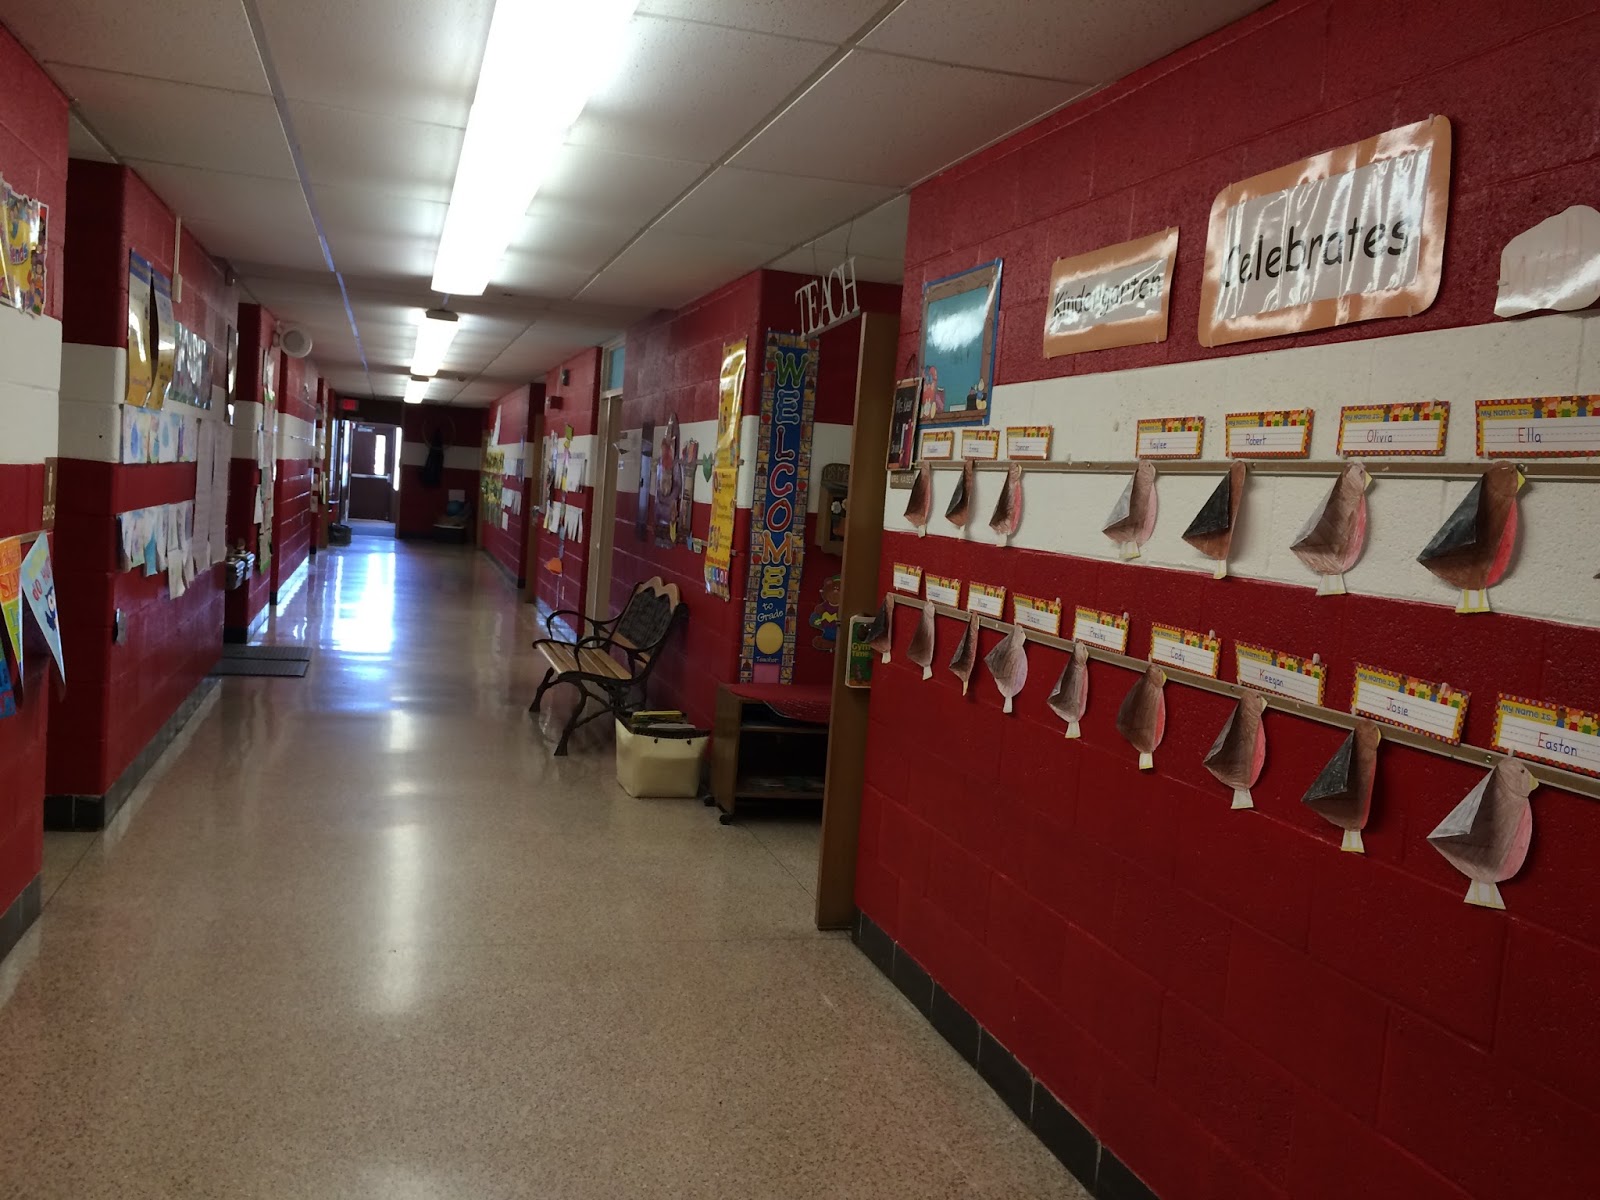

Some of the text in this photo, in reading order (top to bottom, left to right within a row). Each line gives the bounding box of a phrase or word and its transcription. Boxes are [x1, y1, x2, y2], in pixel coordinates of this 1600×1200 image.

[1221, 216, 1412, 288] Celebrates
[795, 256, 861, 341] TEACH
[1054, 274, 1163, 317] Kindergarten
[1493, 409, 1516, 417] Name
[1245, 432, 1268, 446] Robert
[1366, 429, 1393, 443] Olivia
[1517, 427, 1542, 443] Ella
[761, 351, 809, 599] WELCOME
[762, 602, 774, 610] to
[757, 609, 784, 622] Grade
[851, 642, 871, 653] Gym
[851, 650, 870, 658] Time
[1259, 668, 1284, 689] Keegan
[1386, 696, 1409, 716] Josie
[1515, 707, 1538, 719] Name
[1537, 731, 1578, 757] Easton
